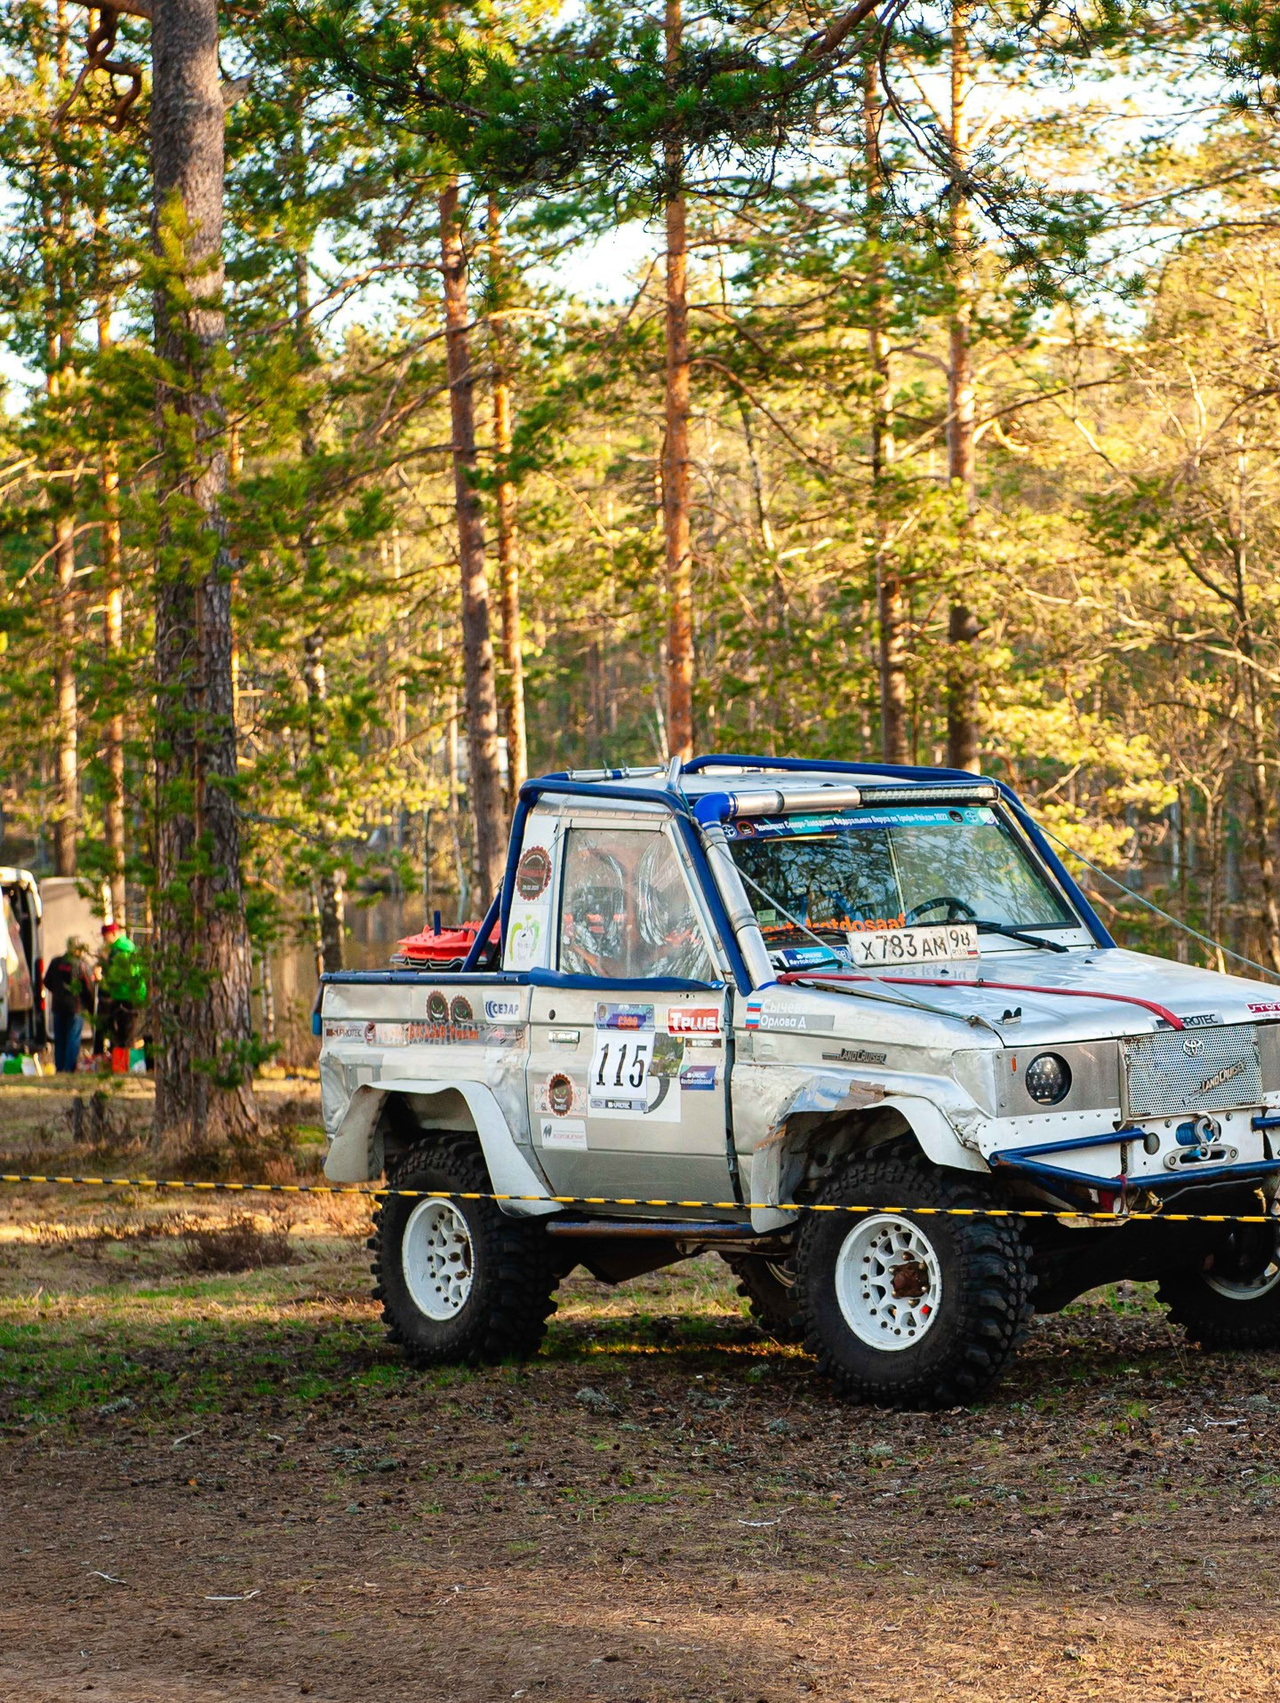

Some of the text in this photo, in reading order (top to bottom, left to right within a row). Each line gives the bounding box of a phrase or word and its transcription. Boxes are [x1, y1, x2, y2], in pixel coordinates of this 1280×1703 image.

[760, 1015, 807, 1029] Орлова Д
[596, 1043, 648, 1088] 115
